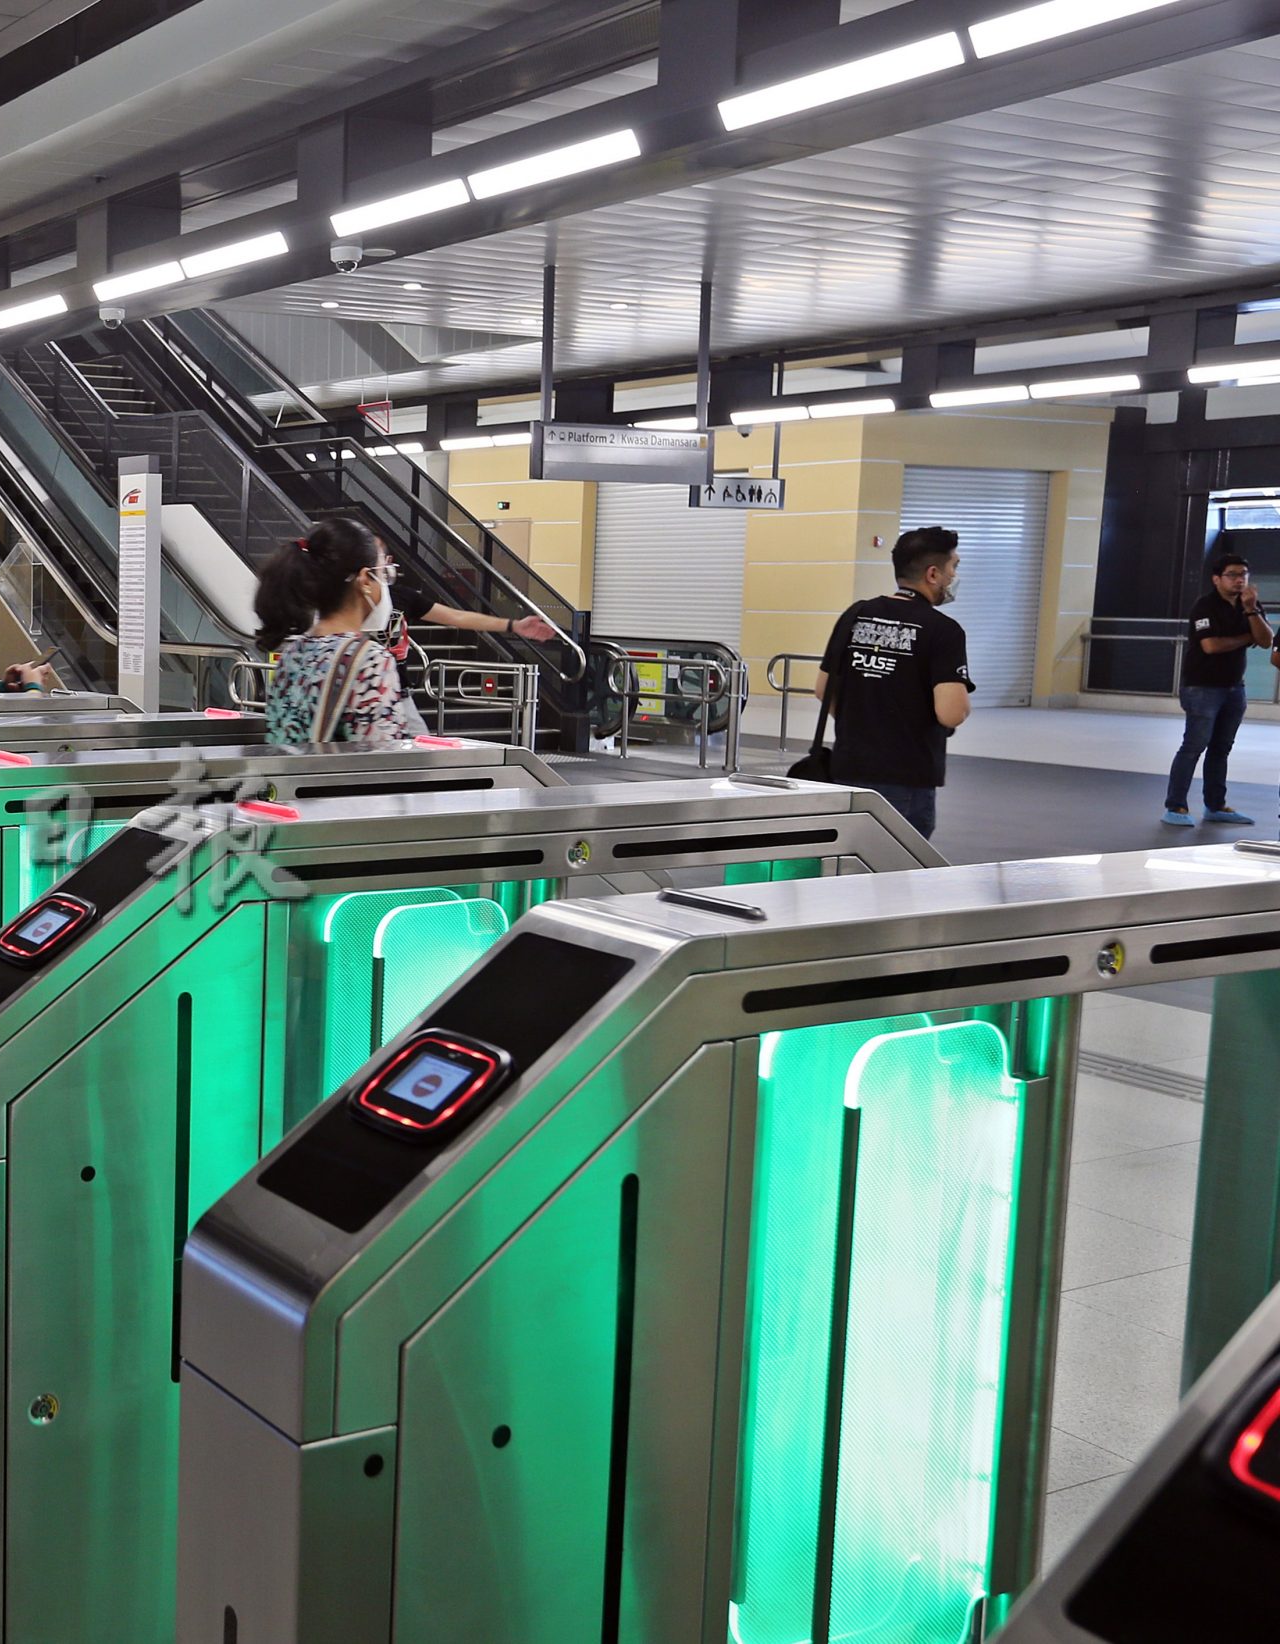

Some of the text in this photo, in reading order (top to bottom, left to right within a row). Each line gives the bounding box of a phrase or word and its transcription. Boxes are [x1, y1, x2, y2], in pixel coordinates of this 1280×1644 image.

[567, 431, 698, 448] Platform 2 Kwasa Damansara
[851, 651, 897, 672] PULSE
